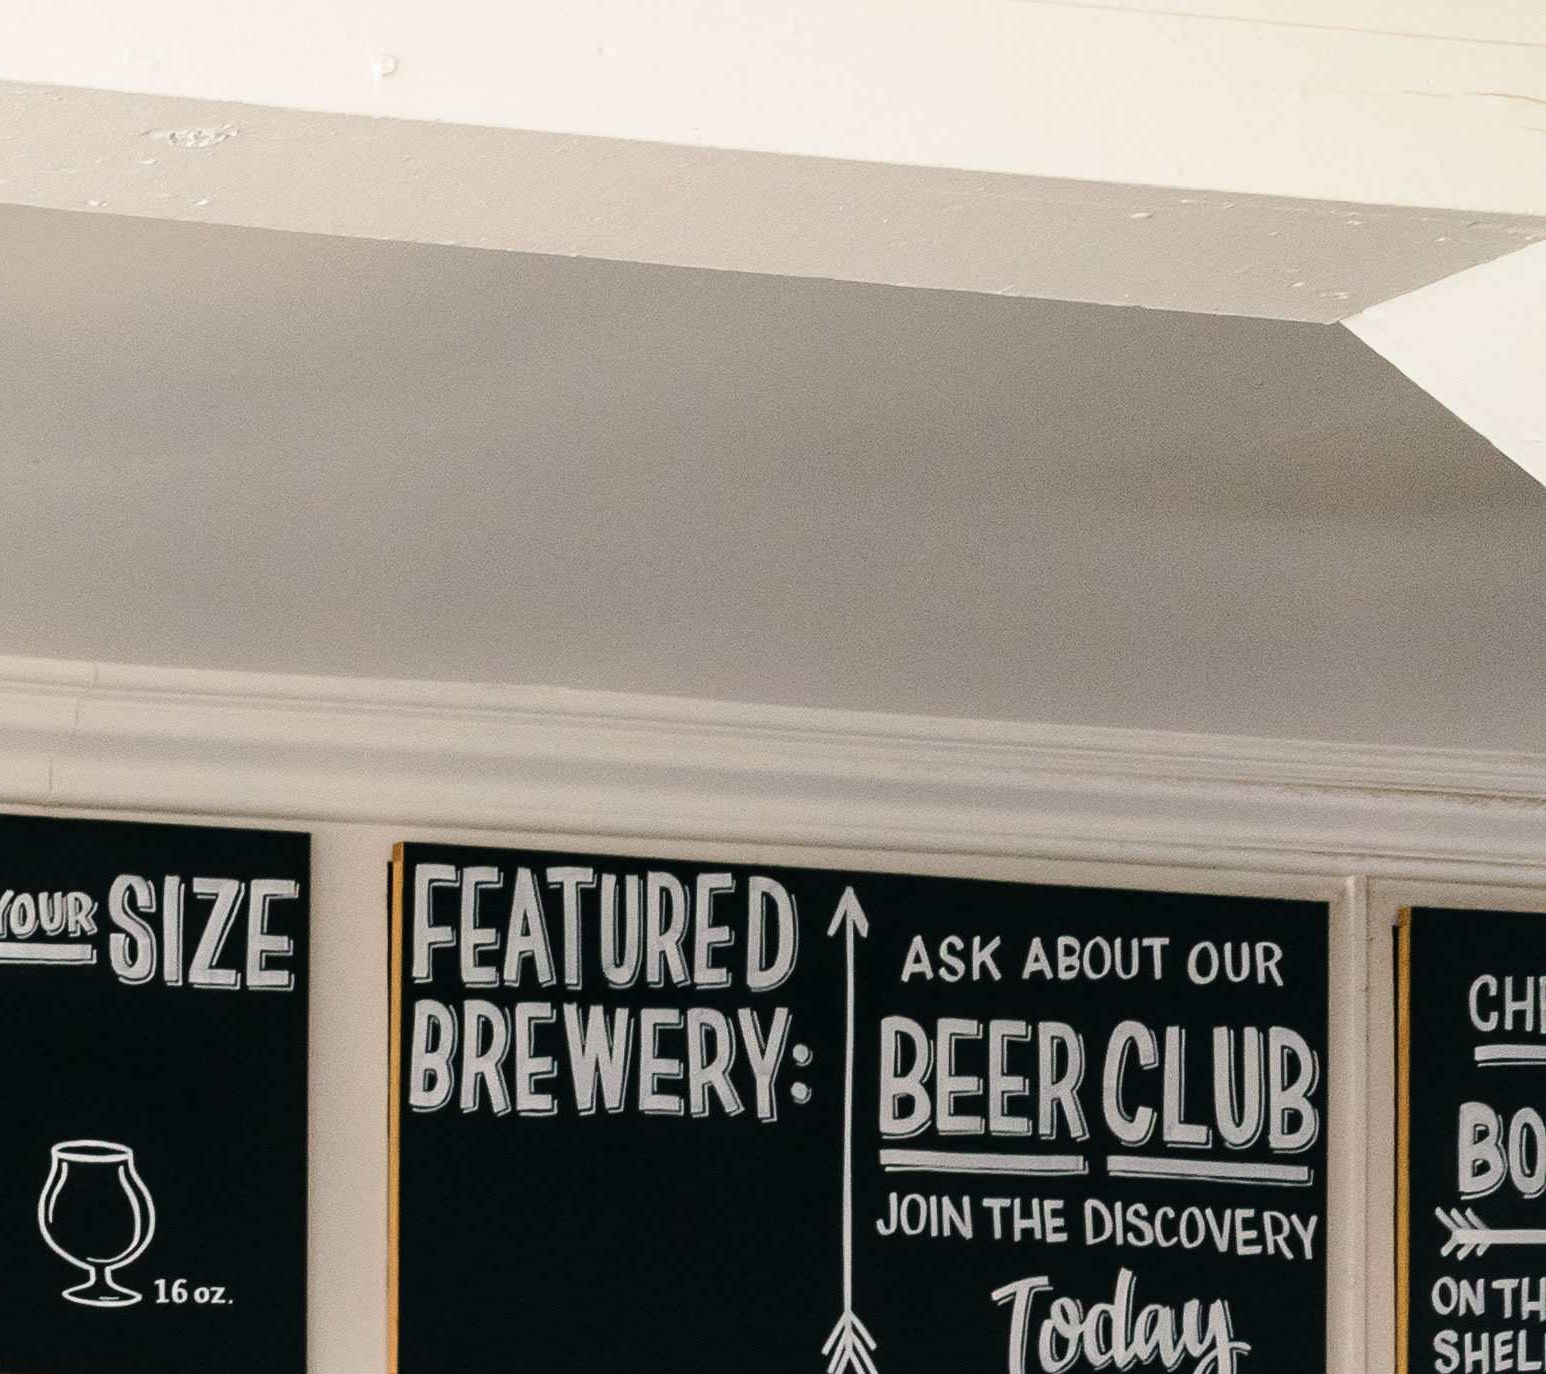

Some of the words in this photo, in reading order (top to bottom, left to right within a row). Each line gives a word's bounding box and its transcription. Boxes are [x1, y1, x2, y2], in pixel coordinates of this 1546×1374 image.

[108, 874, 299, 991] SIZE
[411, 863, 799, 992] FEATURED
[901, 935, 1002, 983] ASK
[1022, 935, 1170, 983] ABOUT
[1187, 941, 1284, 987] OUR
[409, 999, 812, 1122] BREWERY:
[879, 1016, 1090, 1141] BEER
[1102, 1020, 1319, 1153] CLUB
[876, 1193, 972, 1237] JOIN
[983, 1197, 1067, 1243] THE
[1084, 1201, 1317, 1260] DISCOVERY
[1431, 1275, 1485, 1318] ON
